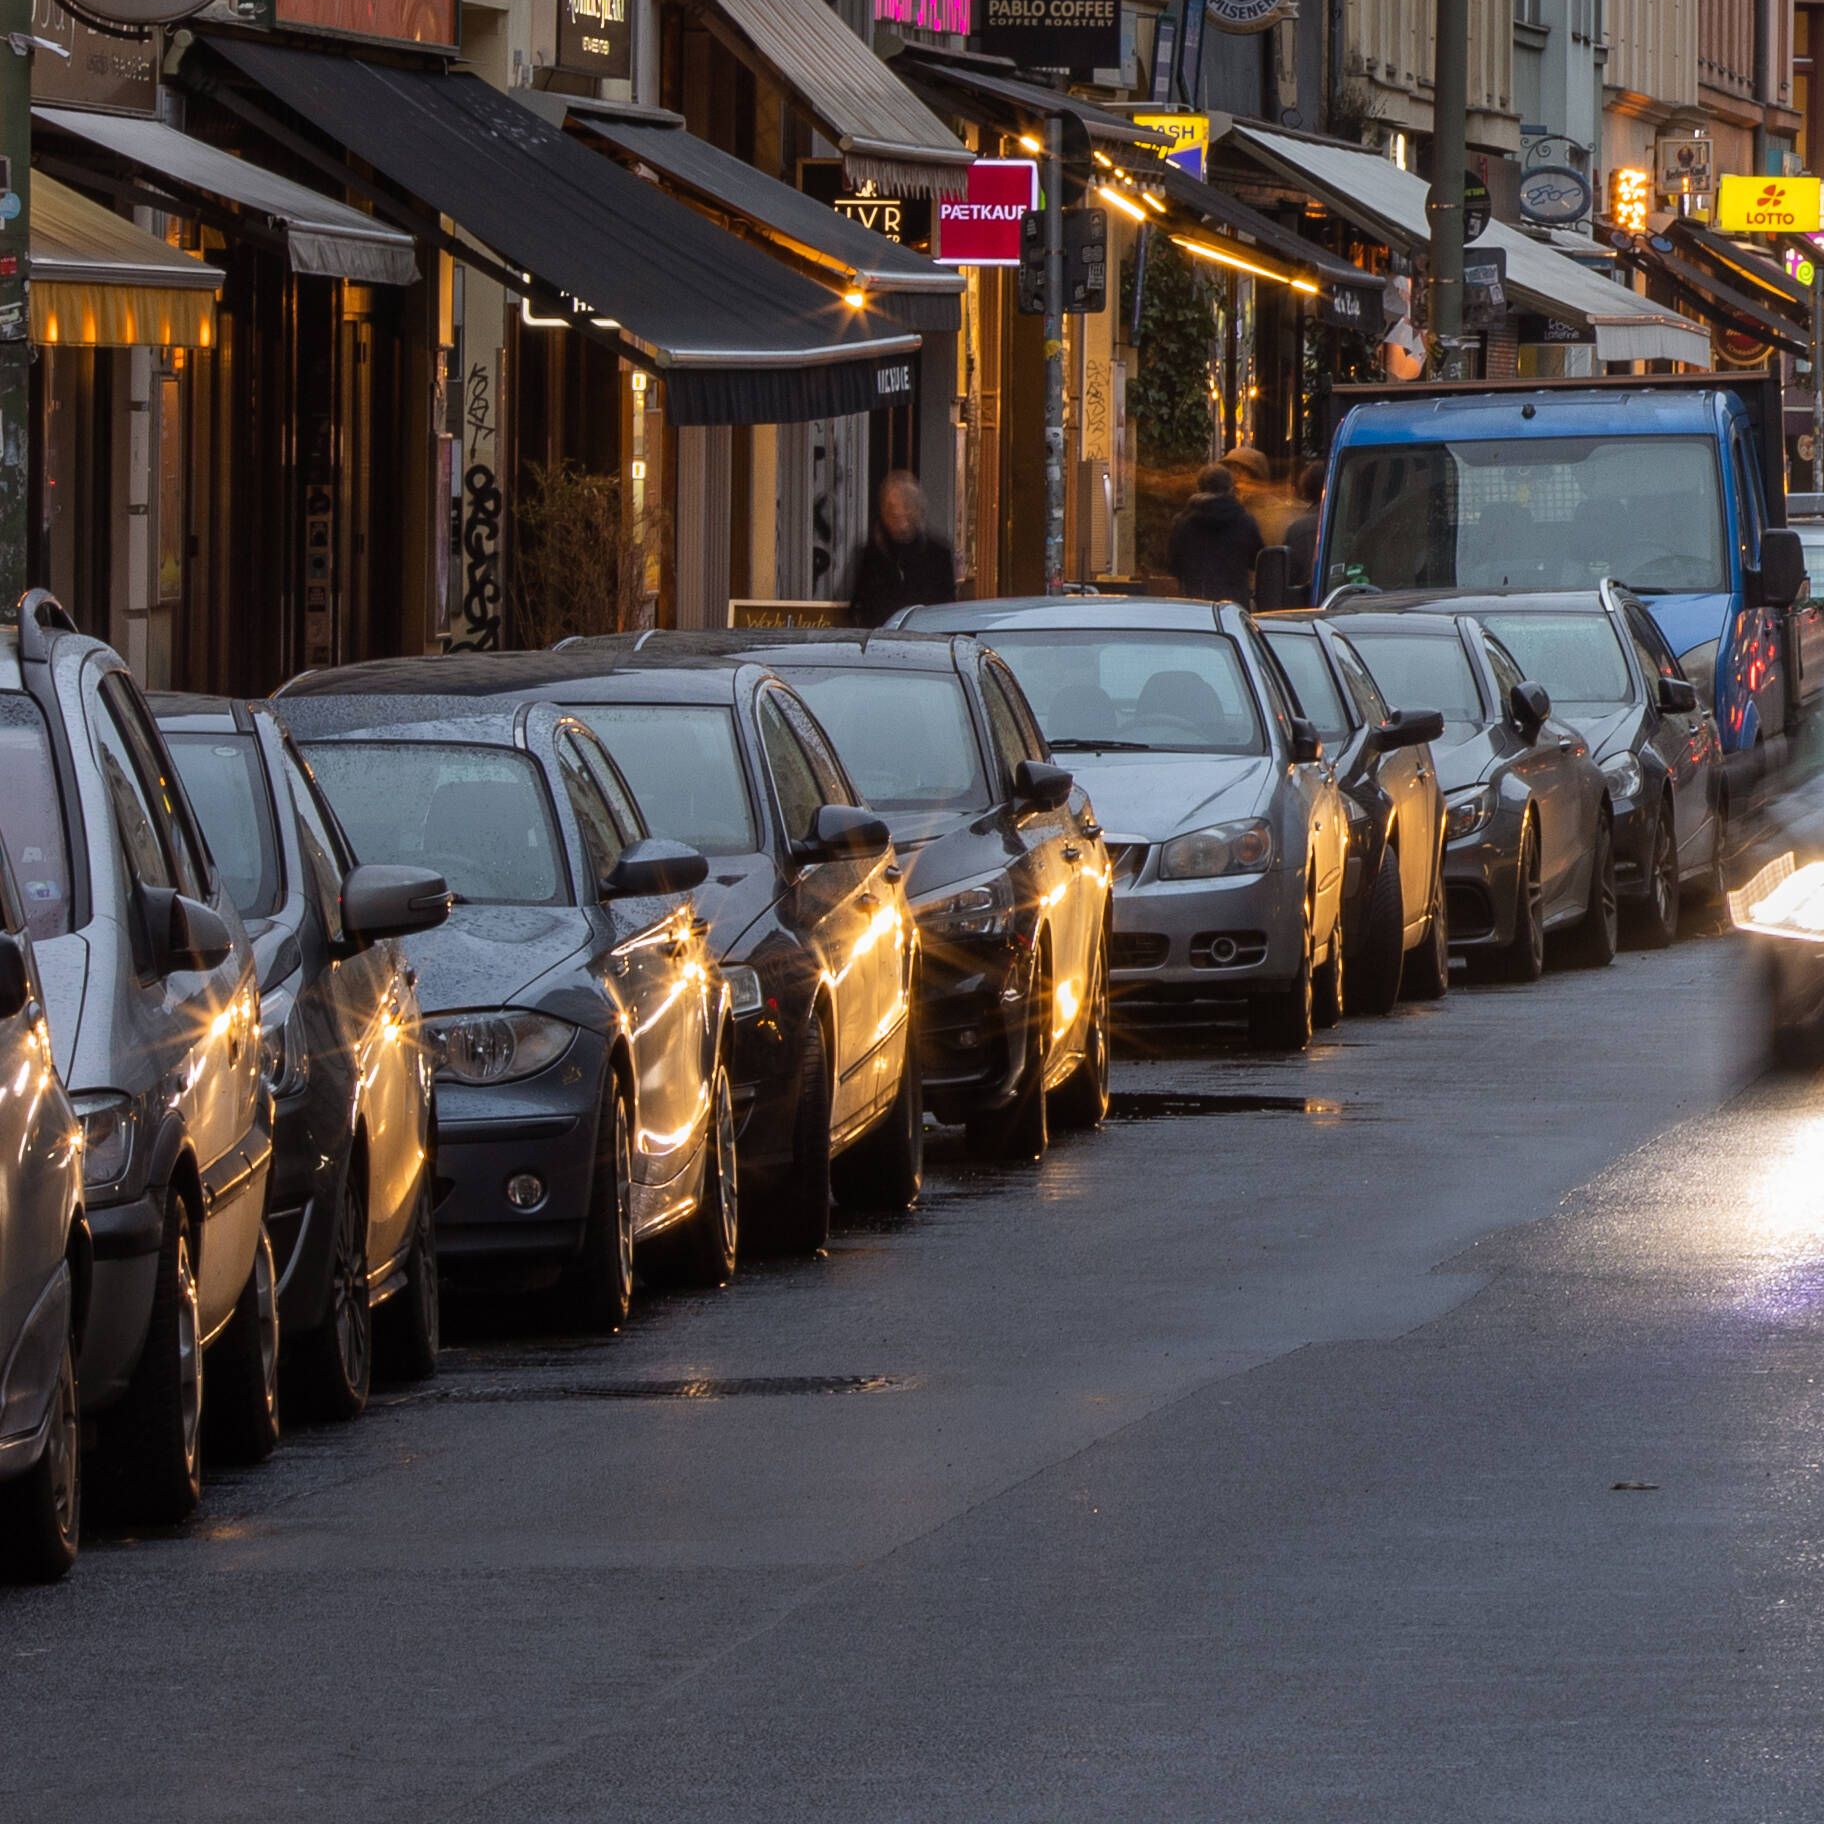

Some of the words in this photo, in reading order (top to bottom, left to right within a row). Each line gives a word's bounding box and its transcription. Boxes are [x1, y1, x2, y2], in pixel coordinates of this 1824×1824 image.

[989, 0, 1044, 17] PABLO
[1050, 1, 1114, 17] COFFEE
[989, 18, 1038, 26] COFFEE
[1155, 126, 1195, 139] ASH
[1746, 212, 1795, 225] LOTTO
